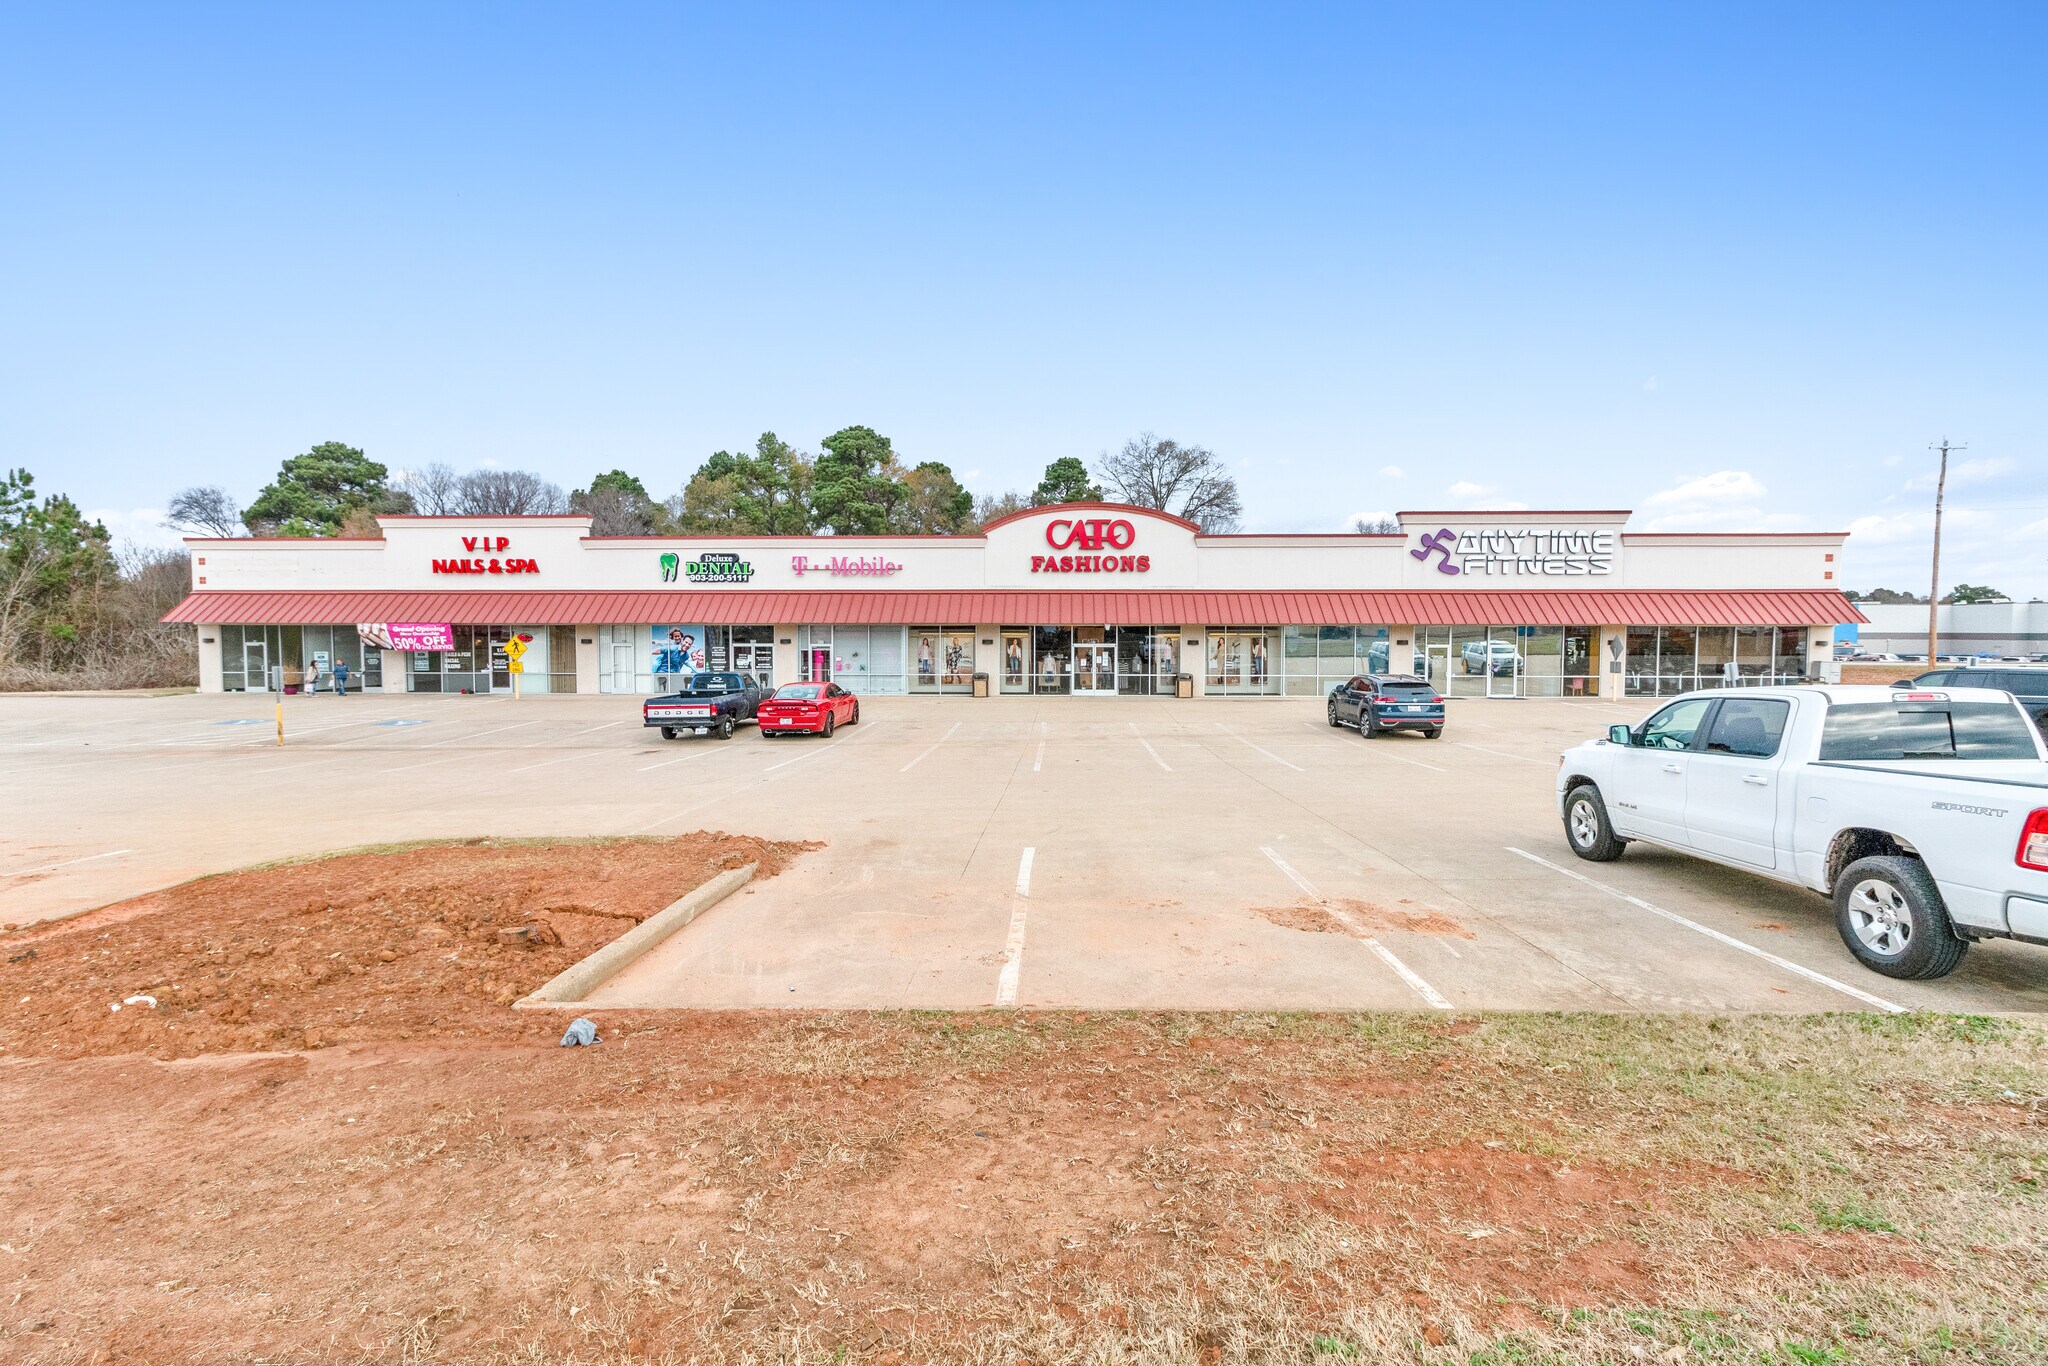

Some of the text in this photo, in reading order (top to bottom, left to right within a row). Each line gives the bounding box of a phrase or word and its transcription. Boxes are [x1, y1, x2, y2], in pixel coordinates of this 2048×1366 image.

[1045, 518, 1136, 551] CATO
[1456, 529, 1615, 555] ANYTIME
[431, 558, 540, 575] NAILS & SPA
[704, 554, 733, 562] Deluxe
[1031, 555, 1151, 573] FASHIONS
[1463, 555, 1614, 575] FITNESS
[685, 561, 754, 575] DENTAL
[690, 573, 747, 582] 903-200-5111
[415, 625, 446, 634] Opening
[394, 636, 447, 650] 50% OFF
[1931, 801, 2009, 818] SPORT
